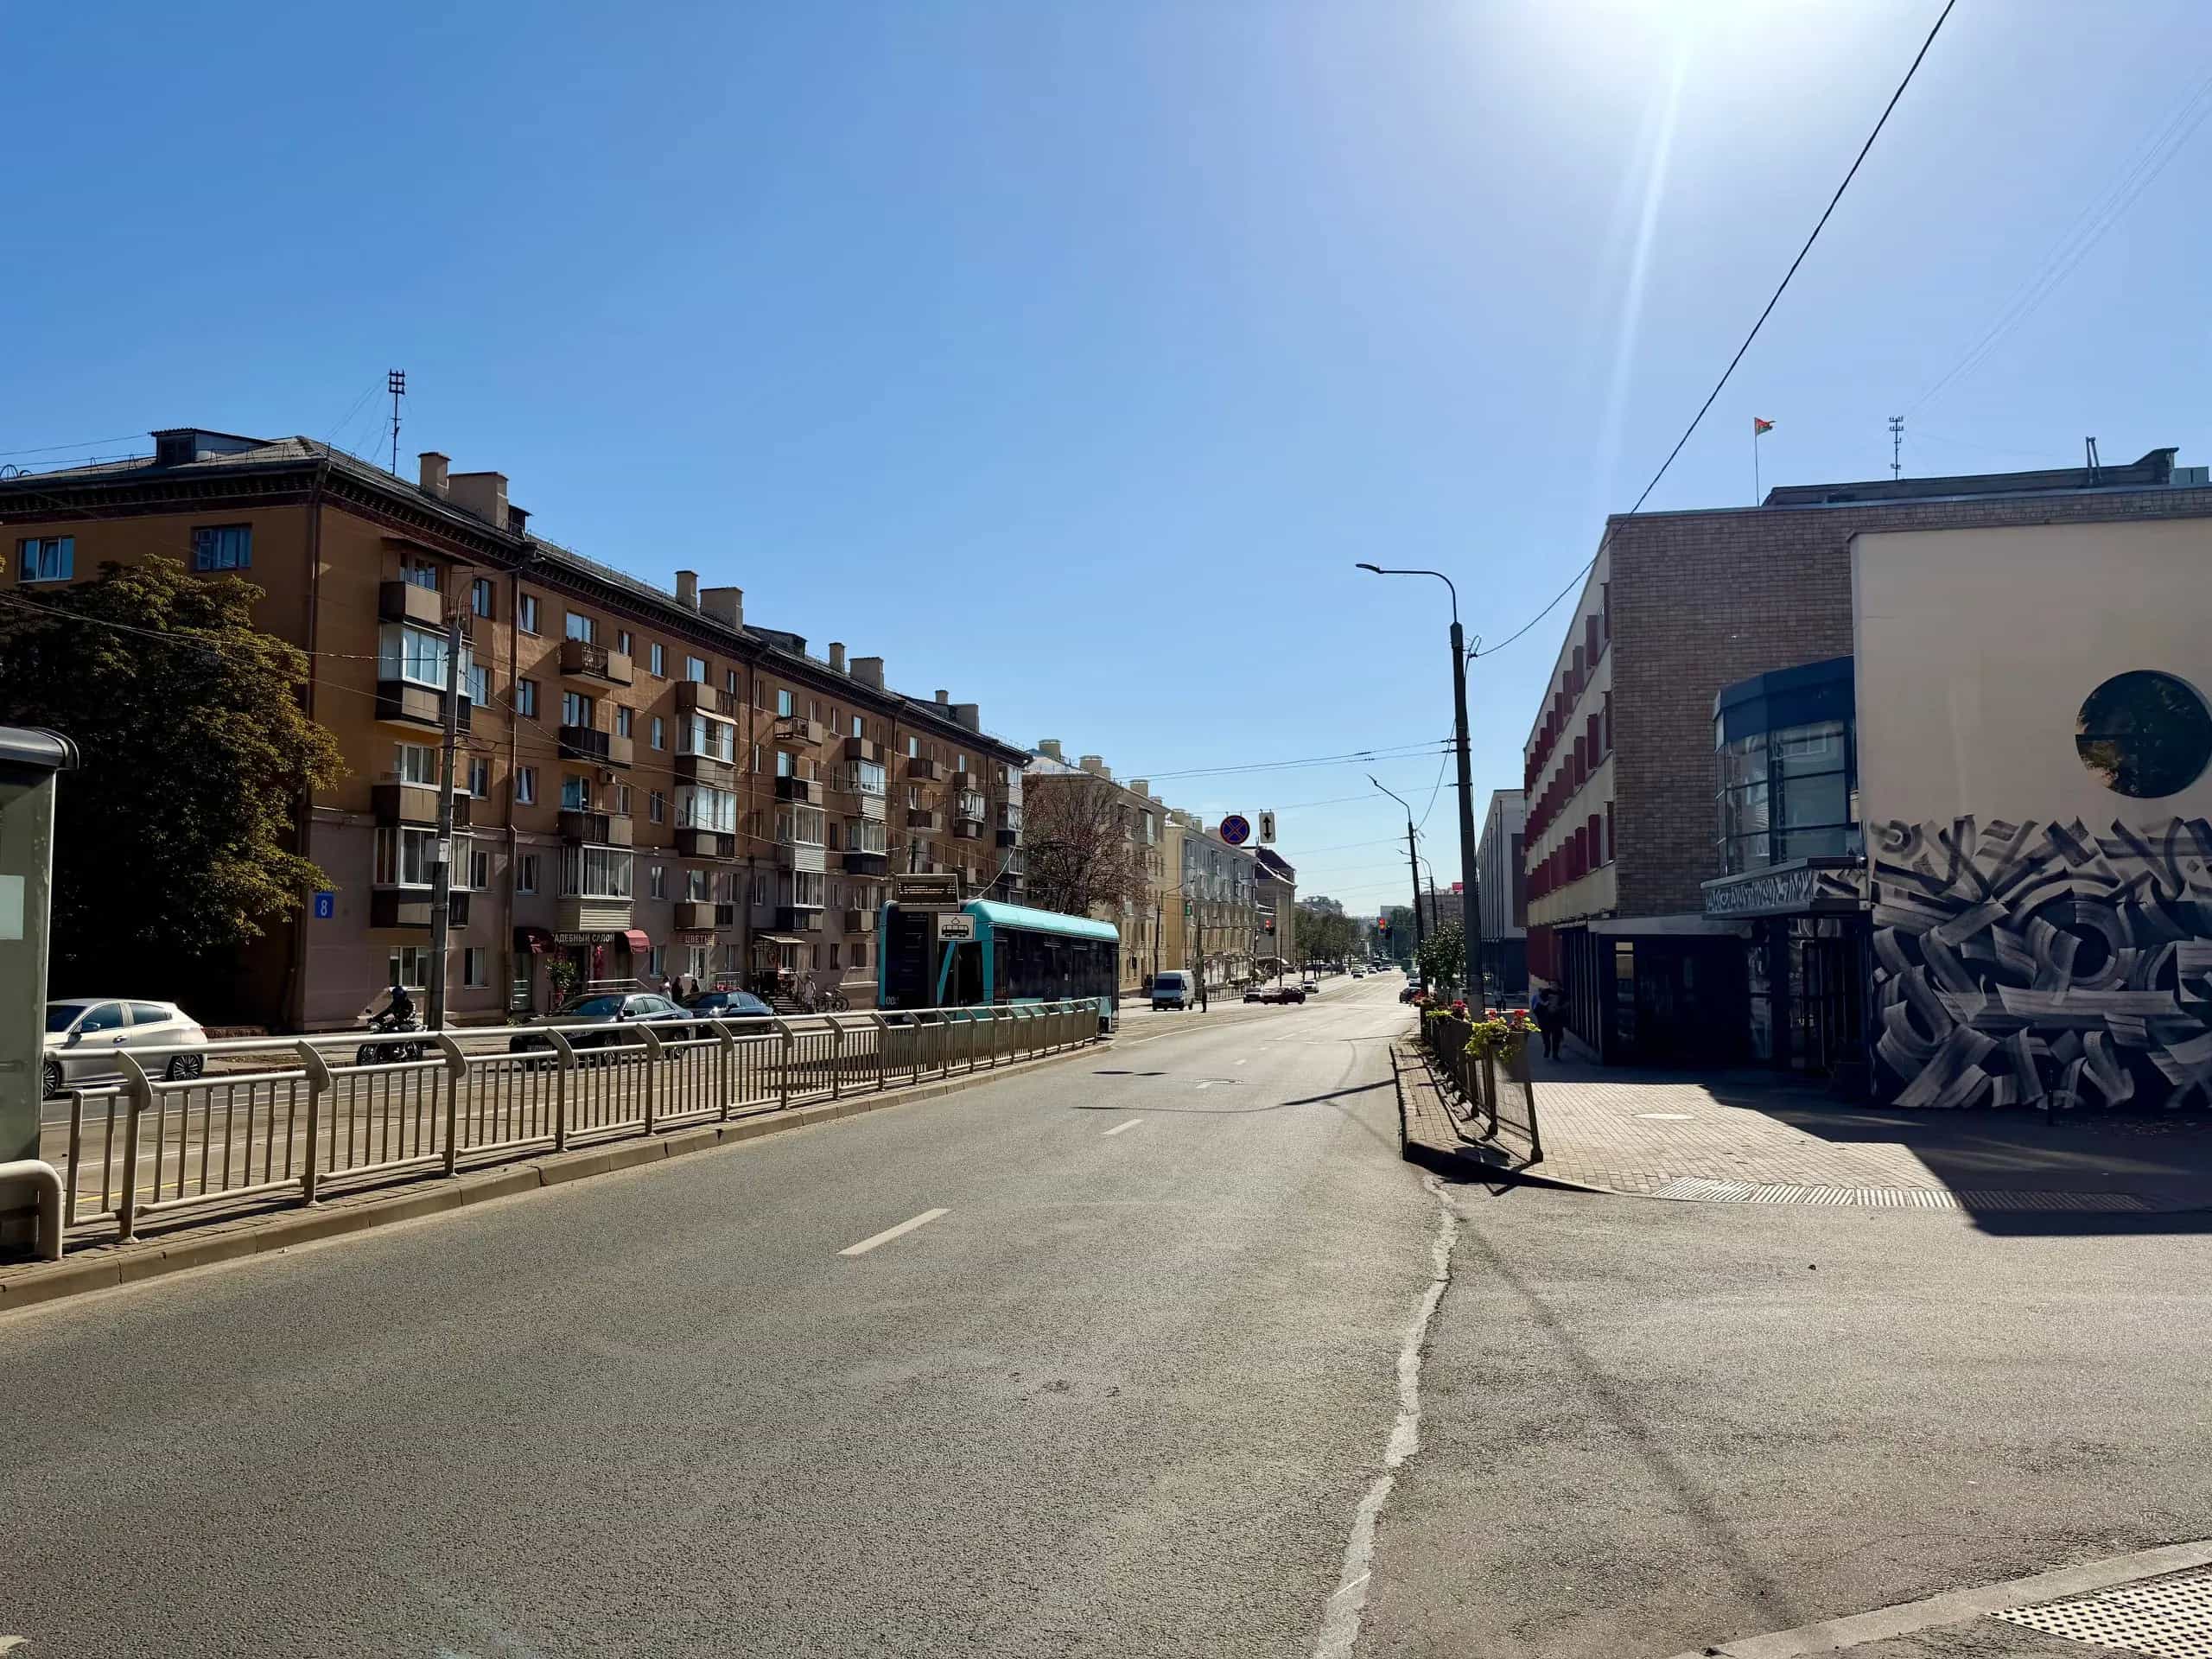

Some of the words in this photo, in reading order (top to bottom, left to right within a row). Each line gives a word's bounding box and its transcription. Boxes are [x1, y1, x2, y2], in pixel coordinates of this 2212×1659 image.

[321, 899, 327, 917] 8
[592, 933, 615, 943] САЛОН
[685, 934, 710, 944] ЦВЕТЫ
